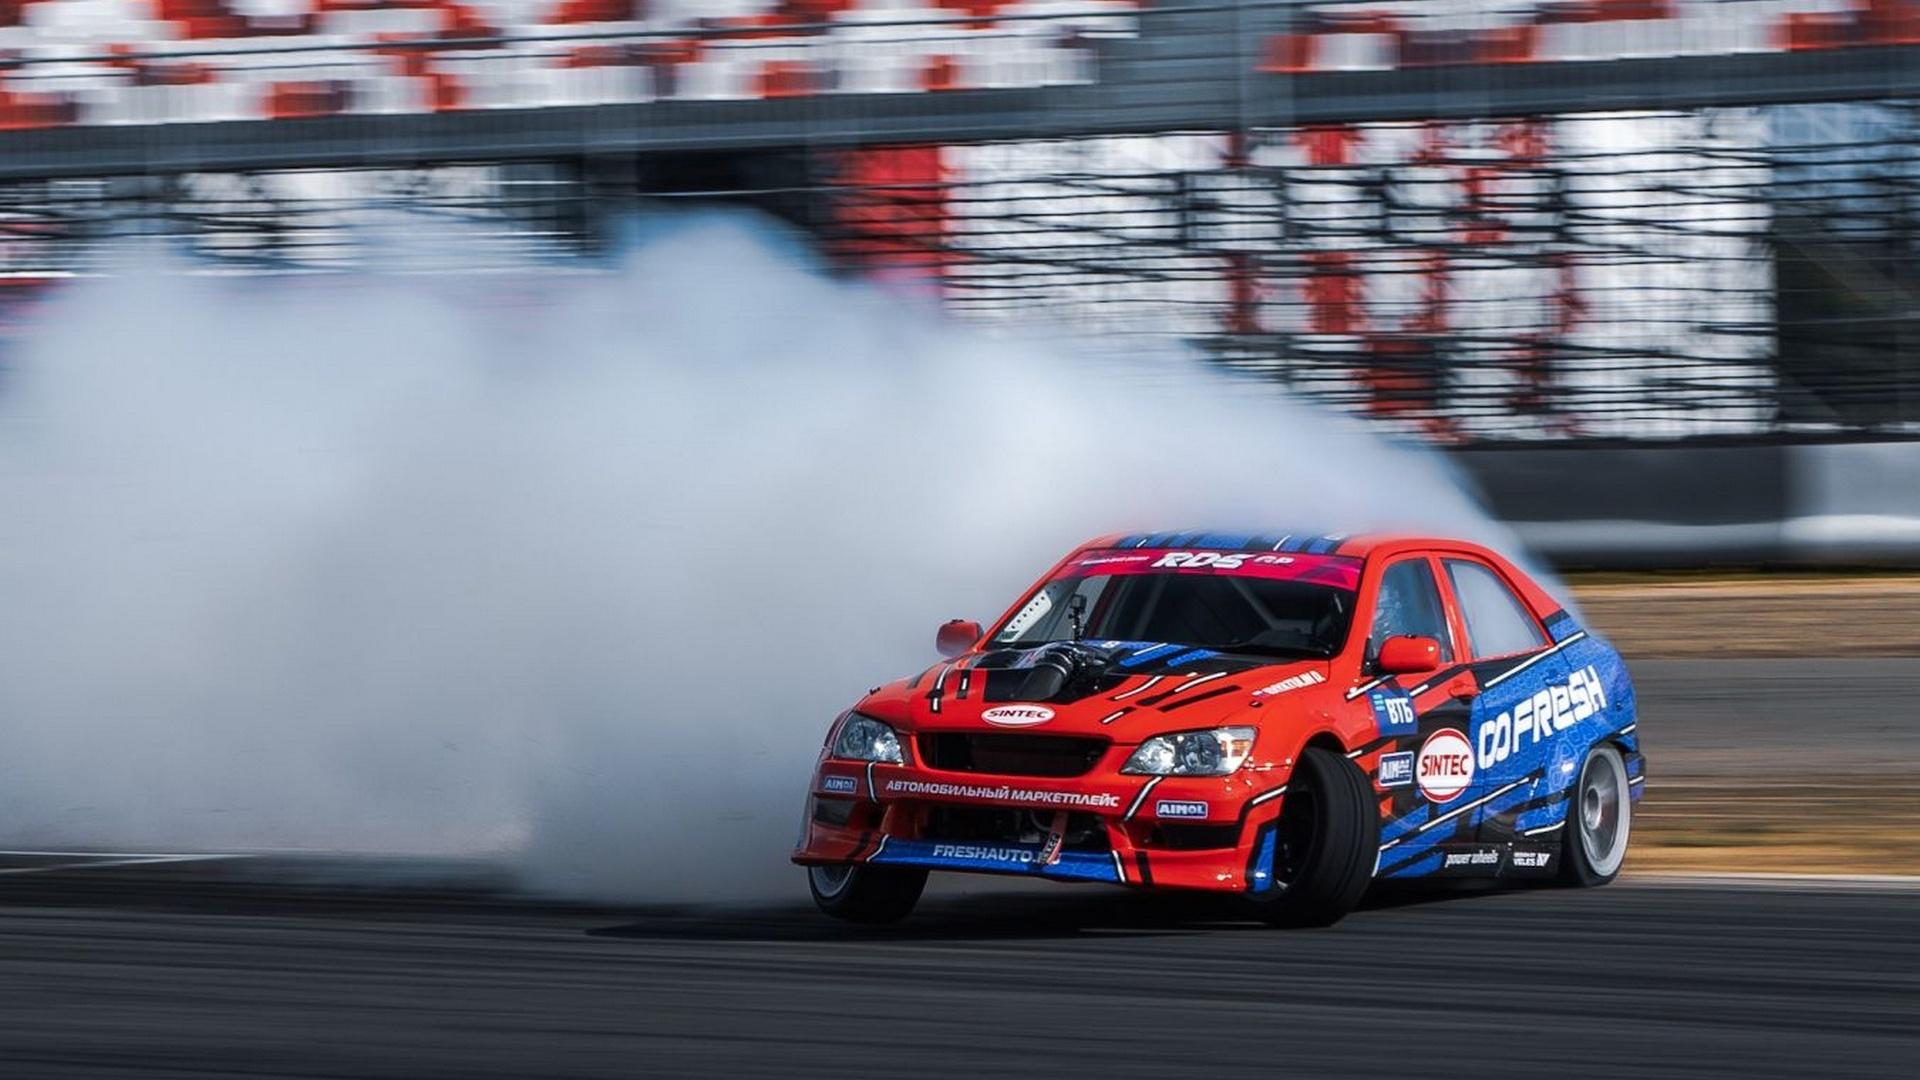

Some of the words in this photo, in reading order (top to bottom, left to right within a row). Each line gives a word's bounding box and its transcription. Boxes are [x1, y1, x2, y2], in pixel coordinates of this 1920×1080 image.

[1151, 552, 1256, 569] RDS
[987, 710, 1049, 718] SINTEC
[1385, 698, 1414, 724] ВТБ
[1421, 754, 1469, 777] SINTEC
[886, 780, 1010, 800] АВТОМОБИЛЬНЫЙ
[1011, 790, 1120, 807] МАРКЕТПЛЕЙС
[1159, 804, 1206, 814] AIMOL
